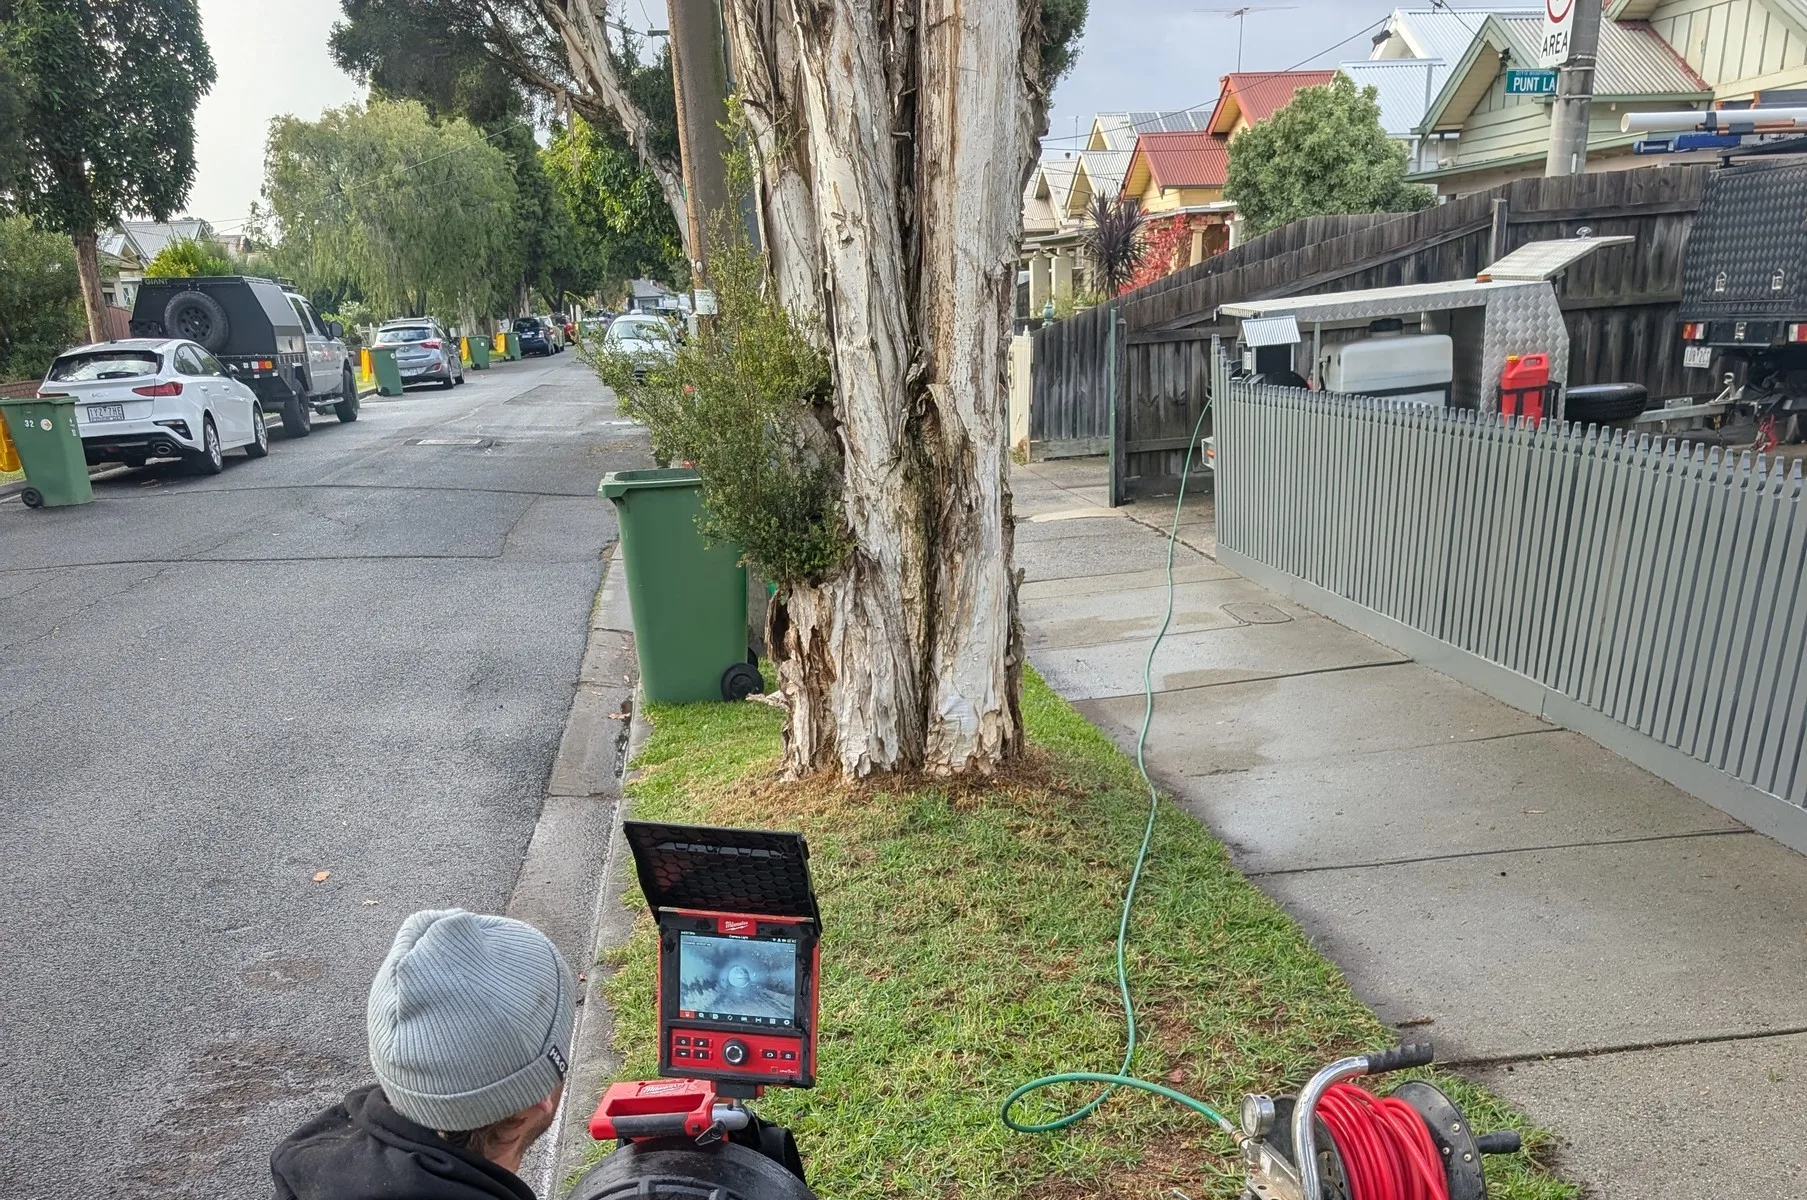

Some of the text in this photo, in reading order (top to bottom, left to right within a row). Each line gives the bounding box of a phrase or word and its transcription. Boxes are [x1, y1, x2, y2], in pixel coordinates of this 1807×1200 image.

[1541, 30, 1568, 58] AREA
[1513, 77, 1555, 91] PUNT LA
[24, 419, 35, 428] 32
[549, 1048, 566, 1072] H&G
